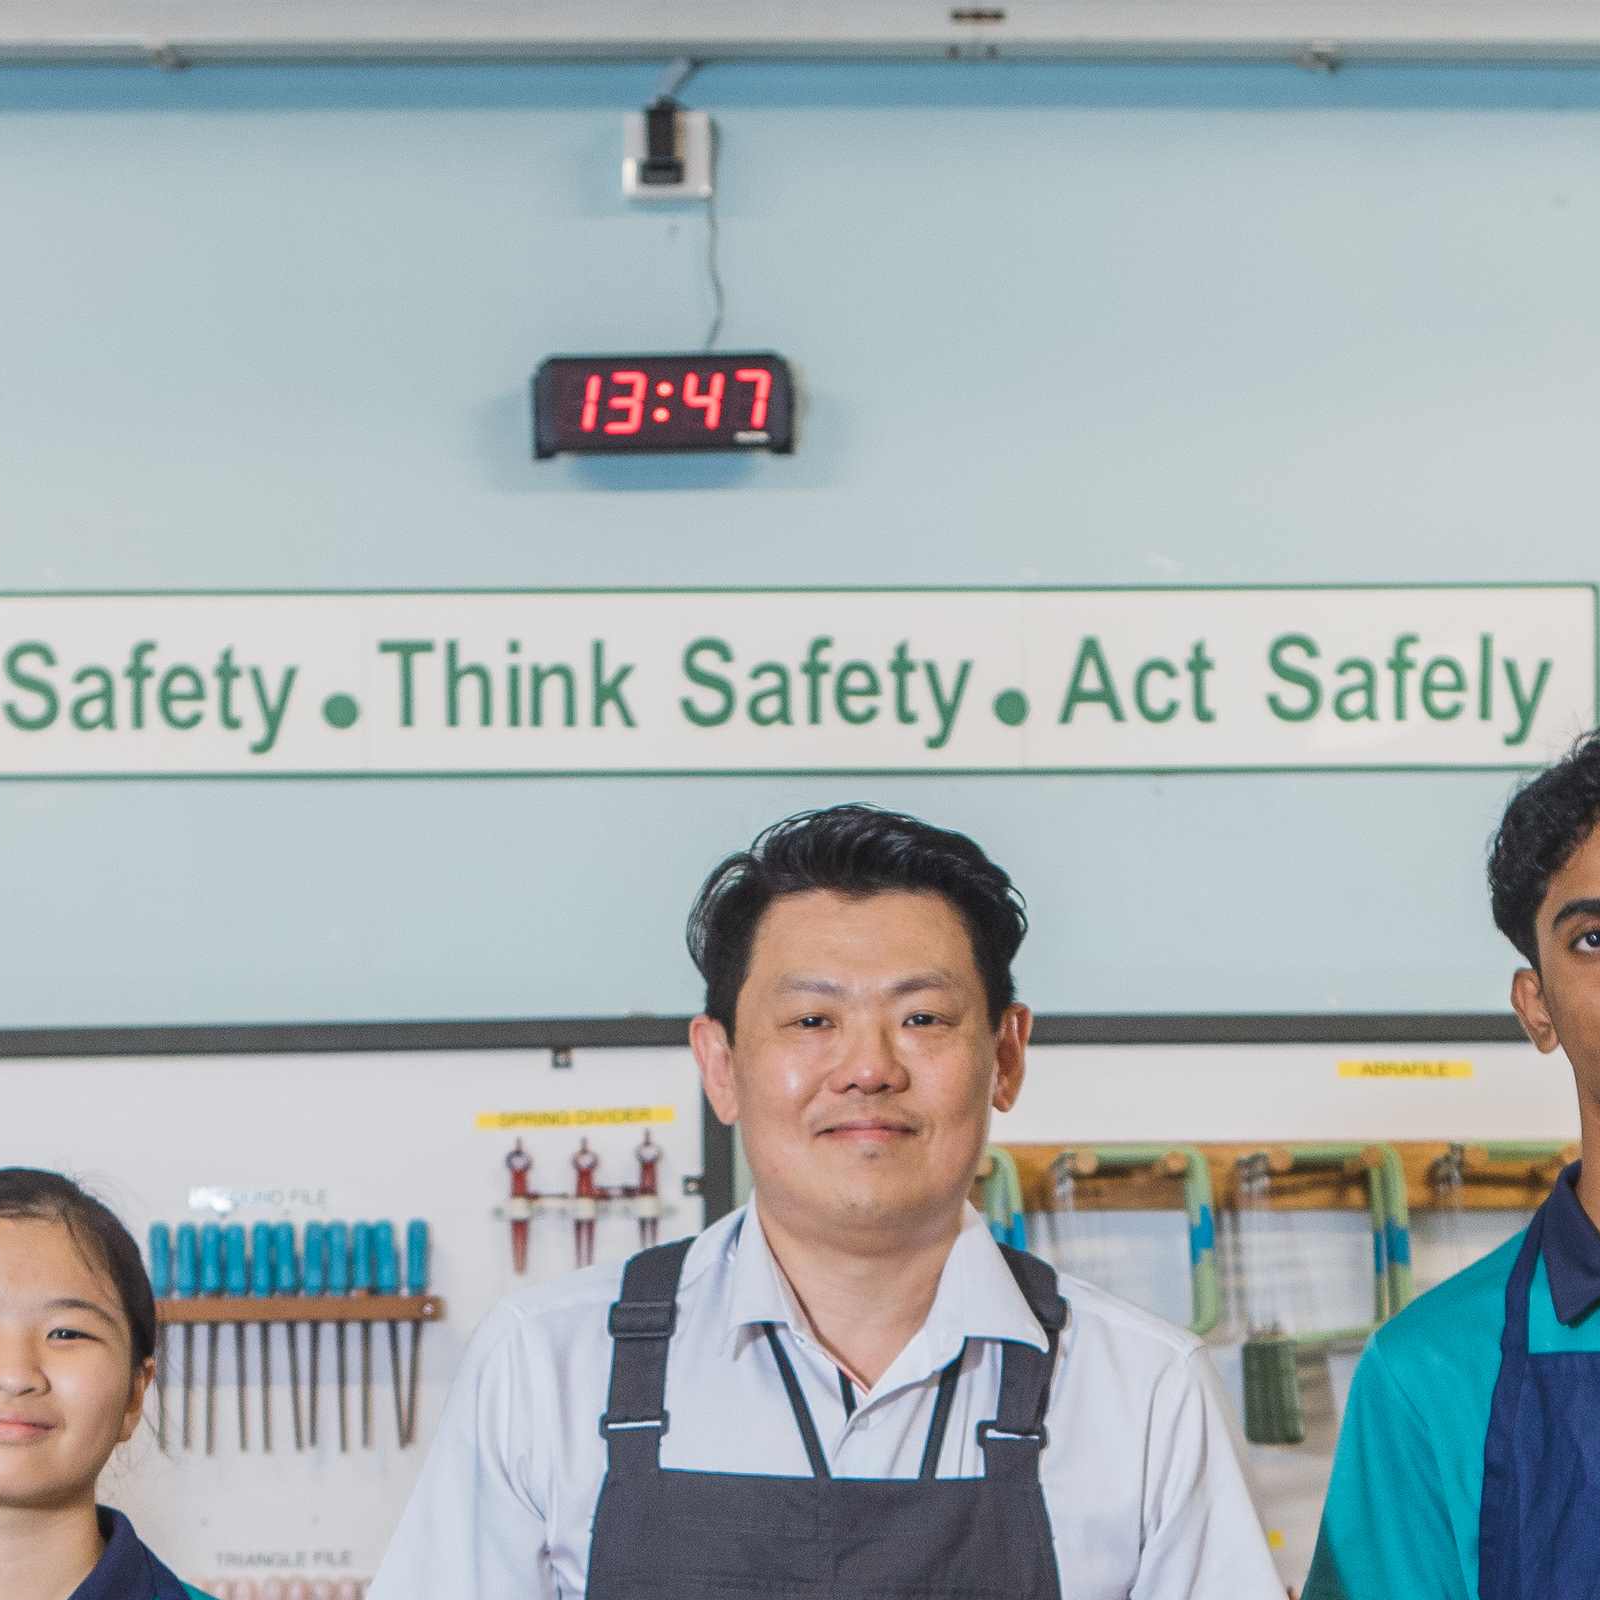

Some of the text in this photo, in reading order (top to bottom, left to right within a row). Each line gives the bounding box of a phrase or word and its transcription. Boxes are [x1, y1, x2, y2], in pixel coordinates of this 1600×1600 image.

[580, 368, 772, 434] 13:47
[3, 641, 297, 755] Safety
[378, 640, 636, 728] Think
[680, 636, 972, 750] Safety
[1059, 635, 1217, 725] Act
[1266, 633, 1553, 747] Safely
[498, 1107, 651, 1127] SPRING DIVIDER
[289, 1188, 328, 1206] FILE
[216, 1550, 353, 1568] TRIANGLE FILE
